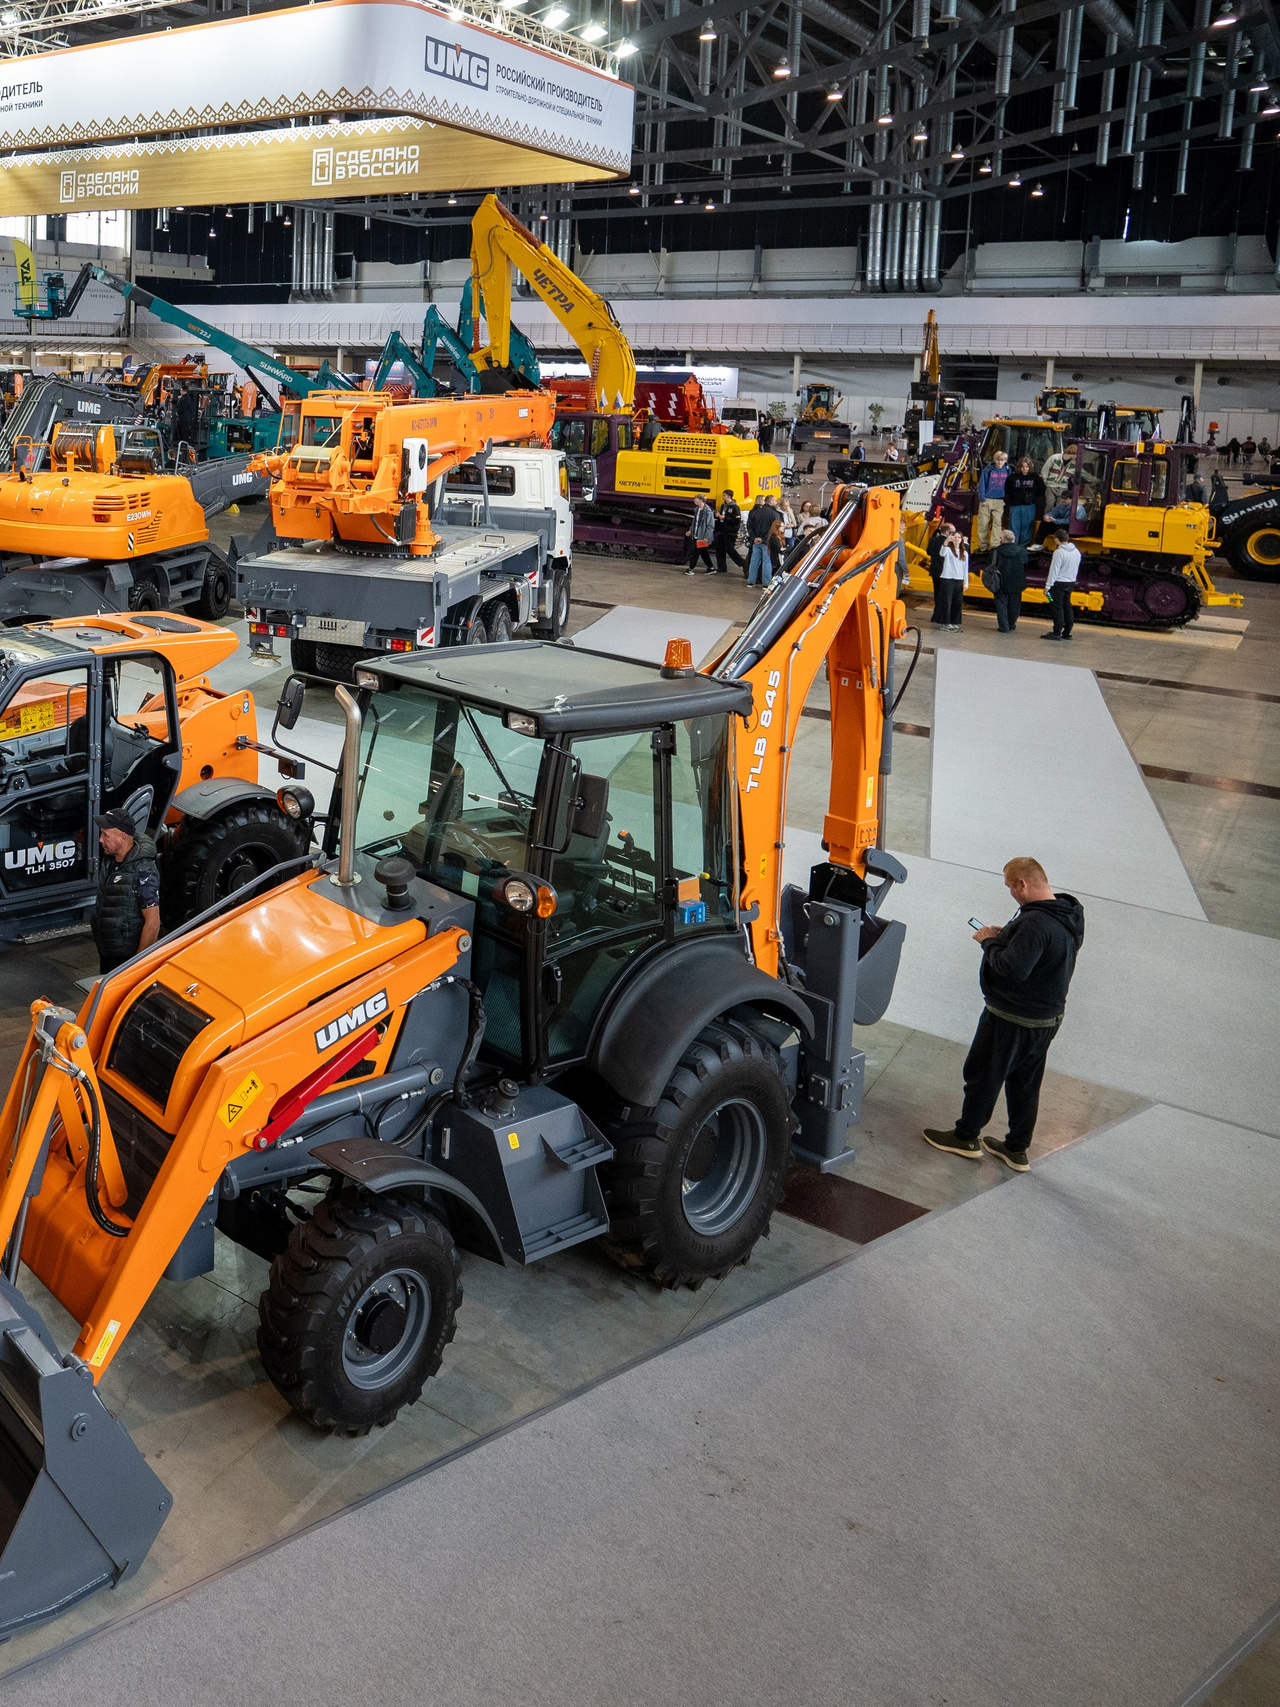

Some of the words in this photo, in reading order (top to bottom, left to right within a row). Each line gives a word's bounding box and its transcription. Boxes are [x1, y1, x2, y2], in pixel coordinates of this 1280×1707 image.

[426, 39, 489, 87] UMG
[495, 63, 546, 93] РОССИЙСКИЙ
[546, 81, 603, 112] ПРОИЗВОДИТЕЛЬ
[14, 99, 44, 111] ТЕХНИКИ
[495, 84, 552, 110] СТРОИТЕЛЬНО-ДОРОЖНОЙ
[555, 105, 585, 121] СПЕЦИАЛЬНОЙ
[585, 114, 603, 126] ТЕХНИКИ
[335, 144, 420, 165] СДЕЛАНО
[77, 169, 140, 184] СДЕЛАНО
[532, 267, 575, 314] ЧЕТРА
[259, 361, 293, 383] SUNWARD
[77, 400, 101, 415] UMG
[232, 472, 253, 486] UMG
[618, 480, 641, 488] ЧЕТРА
[126, 510, 152, 521] E230WH
[746, 737, 767, 793] TLB
[760, 670, 781, 728] 845
[4, 840, 76, 869] UMG
[25, 864, 45, 875] TLH
[49, 858, 75, 870] 3507
[315, 992, 387, 1050] UMG
